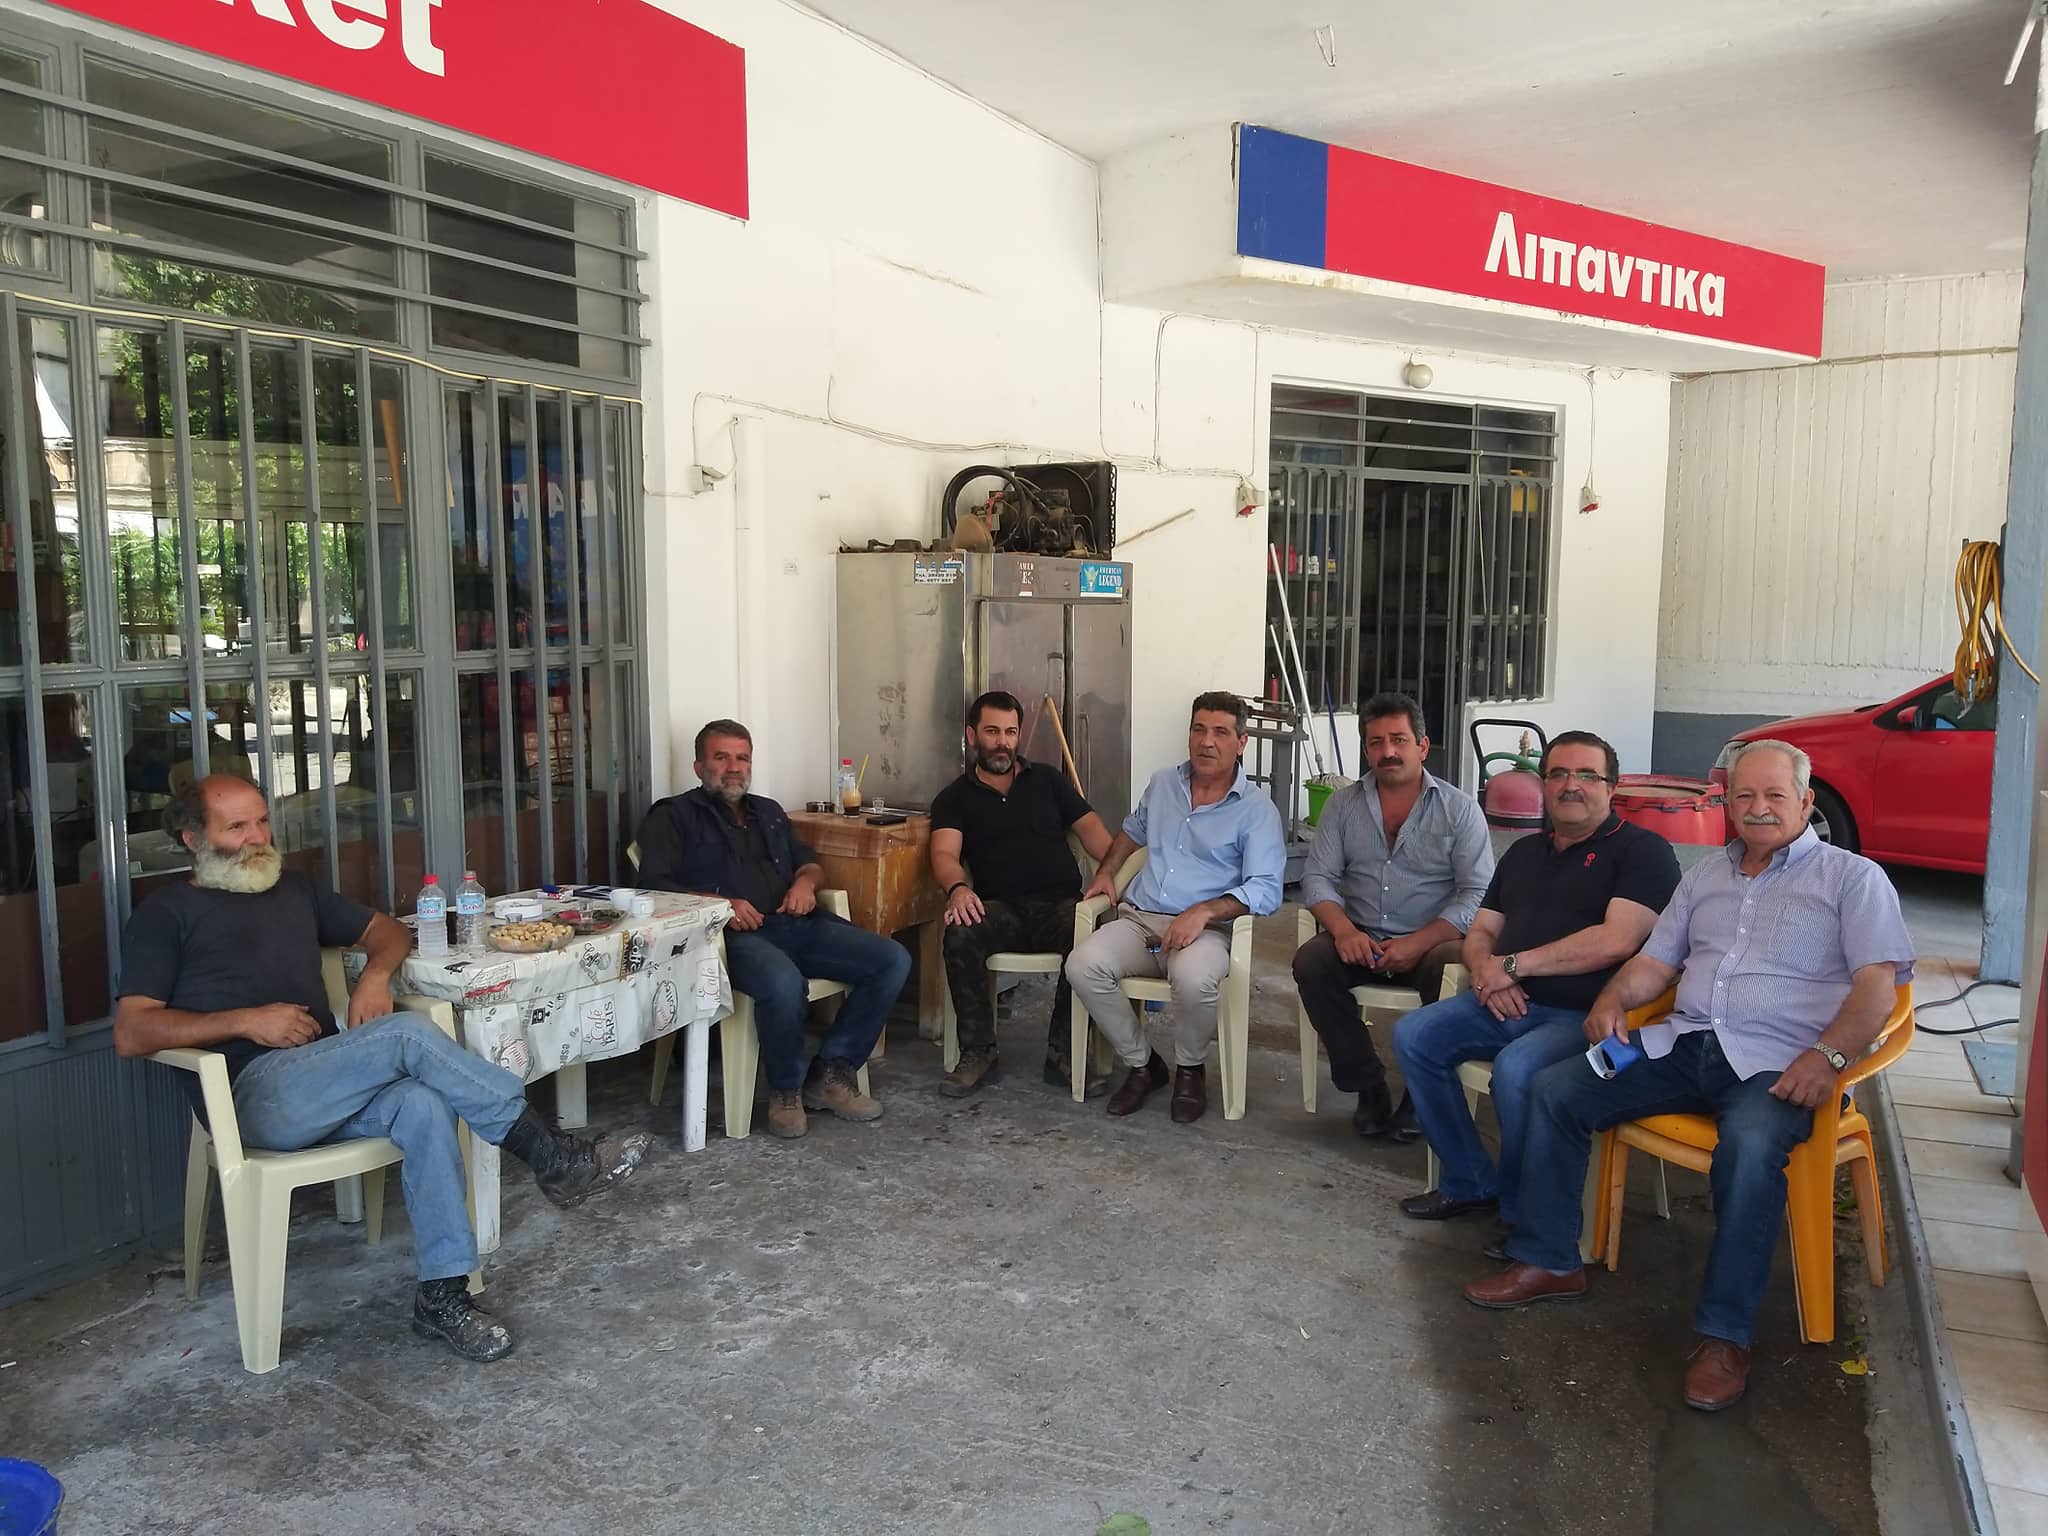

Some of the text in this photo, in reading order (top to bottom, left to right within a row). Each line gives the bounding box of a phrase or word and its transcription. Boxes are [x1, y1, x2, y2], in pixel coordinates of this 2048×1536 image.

[215, 0, 445, 77] et
[1484, 211, 1726, 317] Λιπαντικα
[1098, 574, 1122, 586] LEGEND
[588, 1008, 605, 1042] Café
[602, 1001, 615, 1046] PARIS
